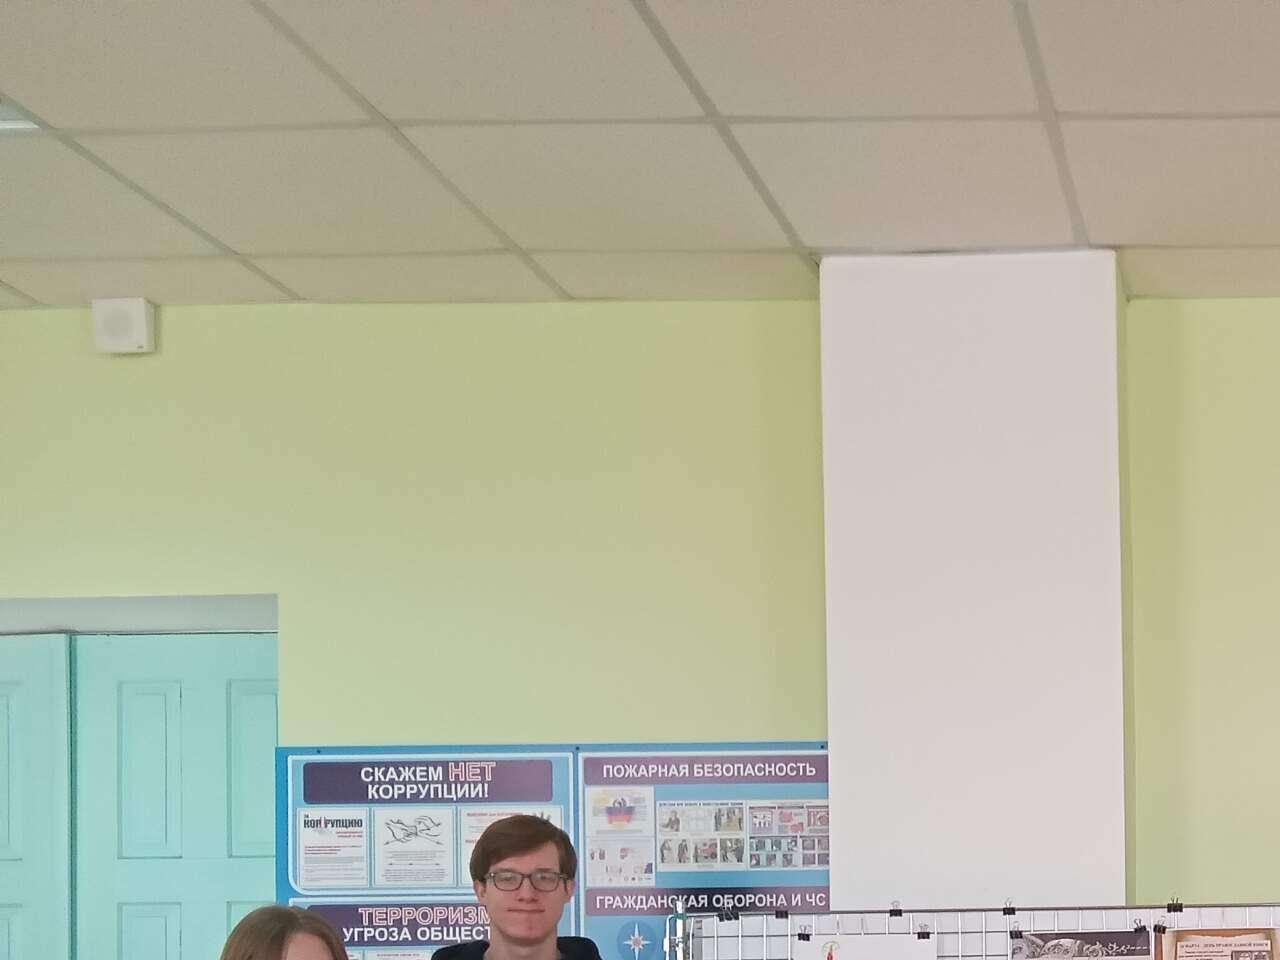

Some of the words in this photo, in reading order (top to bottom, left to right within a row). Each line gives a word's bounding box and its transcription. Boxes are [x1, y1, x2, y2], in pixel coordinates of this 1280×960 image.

[360, 766, 443, 783] СКАЖЕМ
[447, 761, 497, 782] НЕТ
[602, 762, 690, 779] ПОЖАРНАЯ
[693, 762, 817, 778] БЕЗОПАСНОСТЬ
[367, 782, 490, 801] КОРРУПЦИИ!
[712, 893, 788, 908] ОБОРОНА
[790, 893, 801, 906] И
[806, 893, 827, 906] ЧС
[343, 926, 412, 943] УГРОЗА
